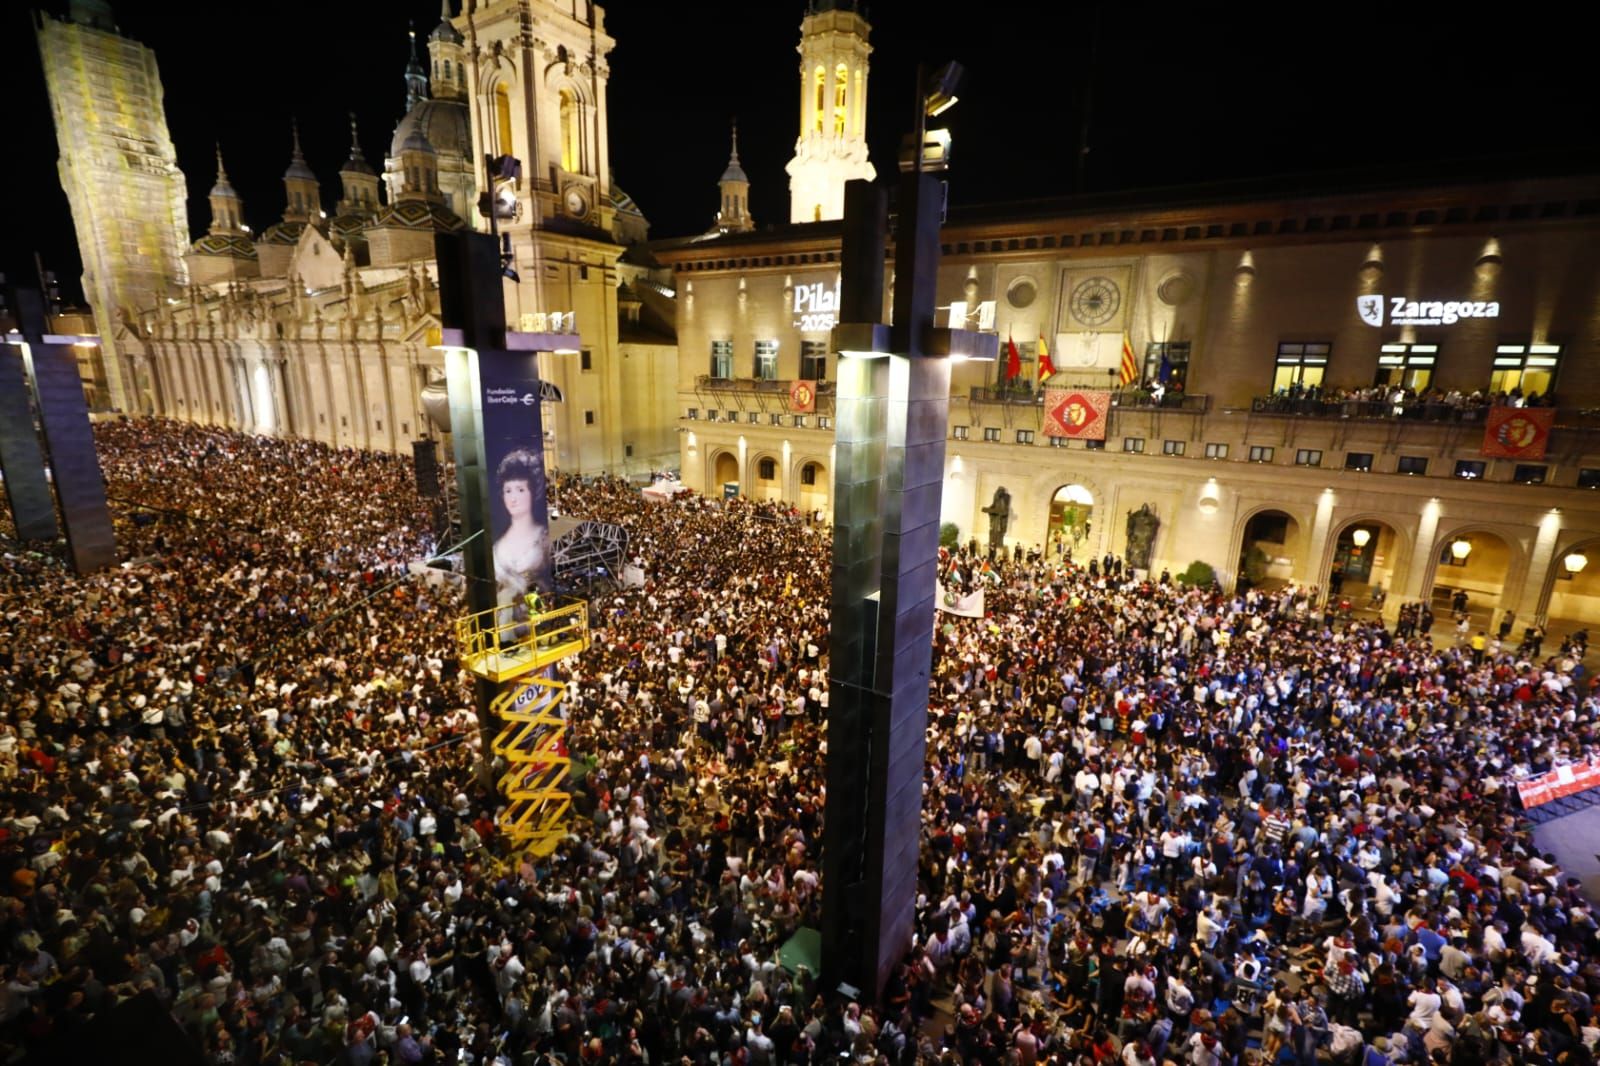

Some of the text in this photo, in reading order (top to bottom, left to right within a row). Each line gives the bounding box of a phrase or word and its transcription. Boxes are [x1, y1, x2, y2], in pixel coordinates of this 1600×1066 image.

[1391, 297, 1499, 324] Zaragoza
[801, 313, 834, 331] 2025
[517, 684, 546, 705] GOY
